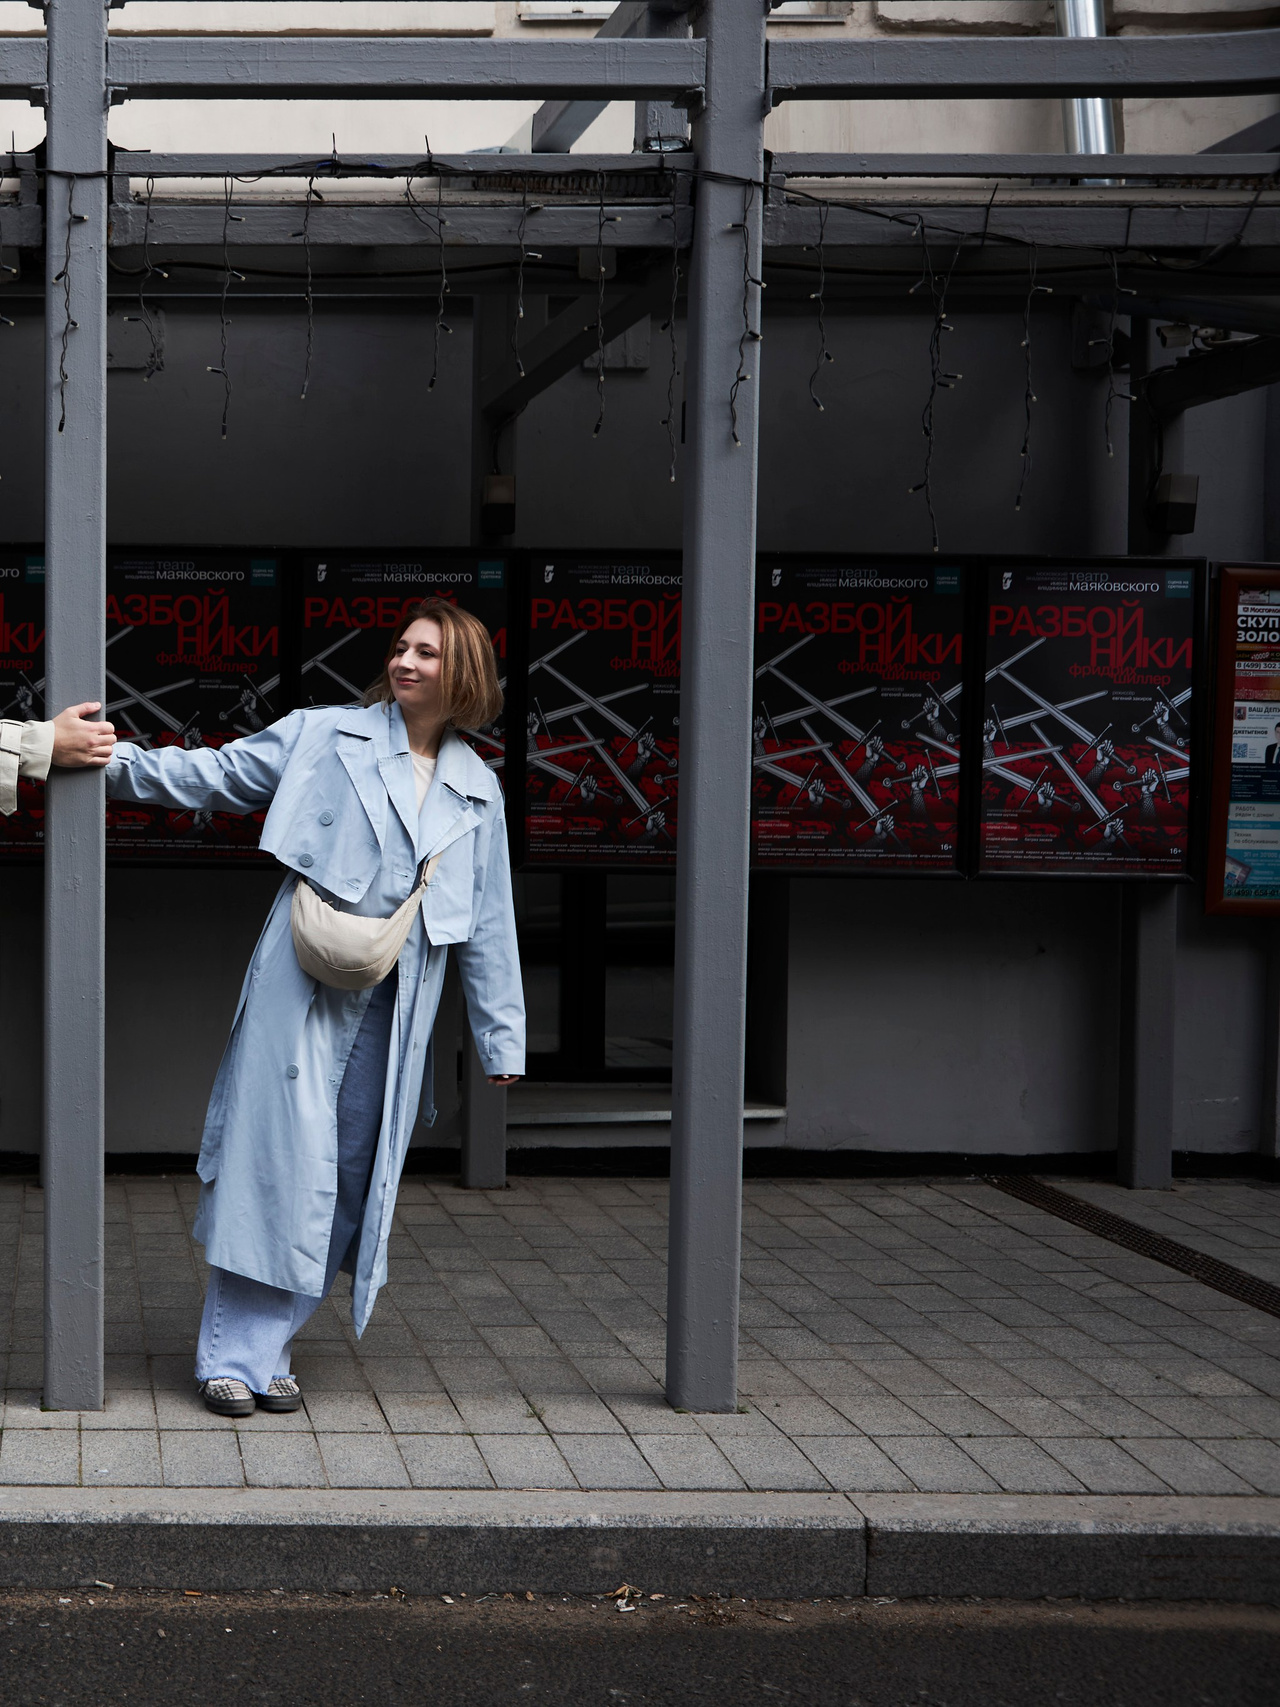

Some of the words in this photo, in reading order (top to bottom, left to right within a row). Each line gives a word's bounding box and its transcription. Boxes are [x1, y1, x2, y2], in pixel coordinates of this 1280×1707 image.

[156, 560, 196, 571] театр
[383, 563, 422, 574] театр
[611, 564, 651, 576] театр
[156, 570, 245, 581] маяковского
[383, 573, 472, 584] маяковского
[838, 567, 879, 578] театр
[1069, 570, 1109, 583] театр
[611, 575, 682, 585] маяковско
[838, 577, 929, 589] маяковского
[1068, 581, 1160, 593] маяковского
[107, 587, 230, 627] АЗБОЙ
[530, 592, 682, 632] РАЗБОЙ
[757, 594, 913, 635] РАЗБОЙ
[988, 599, 1144, 639] РАЗБОЙ
[177, 625, 279, 657] НИКИ
[859, 632, 963, 665] НИКИ
[1090, 636, 1193, 669] НИКИ
[156, 650, 224, 666] фридрих
[610, 656, 678, 671] фридрих
[200, 662, 258, 674] шиллер
[837, 659, 906, 675] фридрих
[1068, 663, 1138, 679] фридрих
[1243, 662, 1261, 670] (499)
[882, 669, 941, 684] шиллер
[1113, 673, 1171, 687] шиллер
[940, 843, 953, 852] 16+
[1169, 847, 1182, 856] 16+
